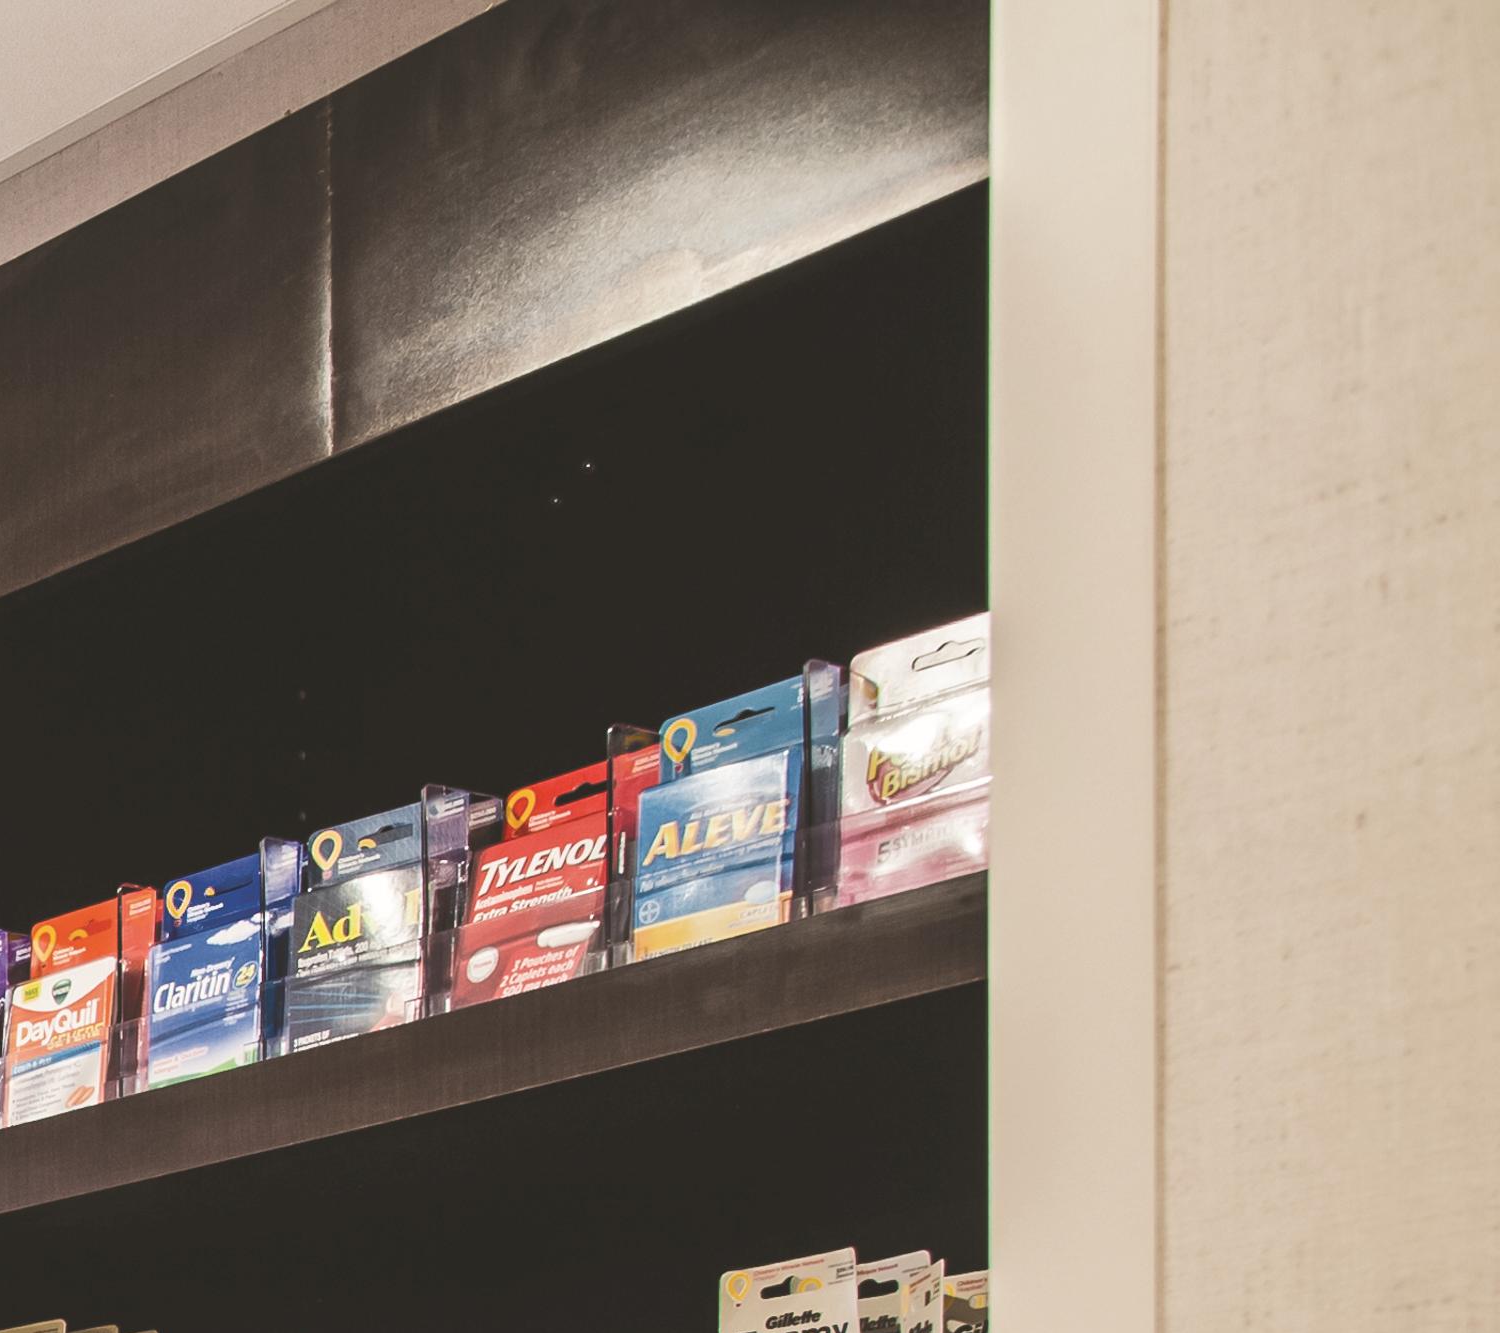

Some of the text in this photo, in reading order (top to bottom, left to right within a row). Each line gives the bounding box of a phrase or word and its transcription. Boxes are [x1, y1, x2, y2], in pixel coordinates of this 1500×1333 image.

[643, 799, 789, 866] ALEVE
[479, 834, 607, 896] TYLENOL
[472, 884, 574, 923] Extra Strength
[236, 965, 255, 980] 24
[512, 946, 579, 972] 3 Pouches of
[153, 969, 231, 1014] Claritin
[15, 998, 99, 1050] DayQuil
[48, 1022, 105, 1050] SEVERE
[765, 1309, 821, 1331] Gillette
